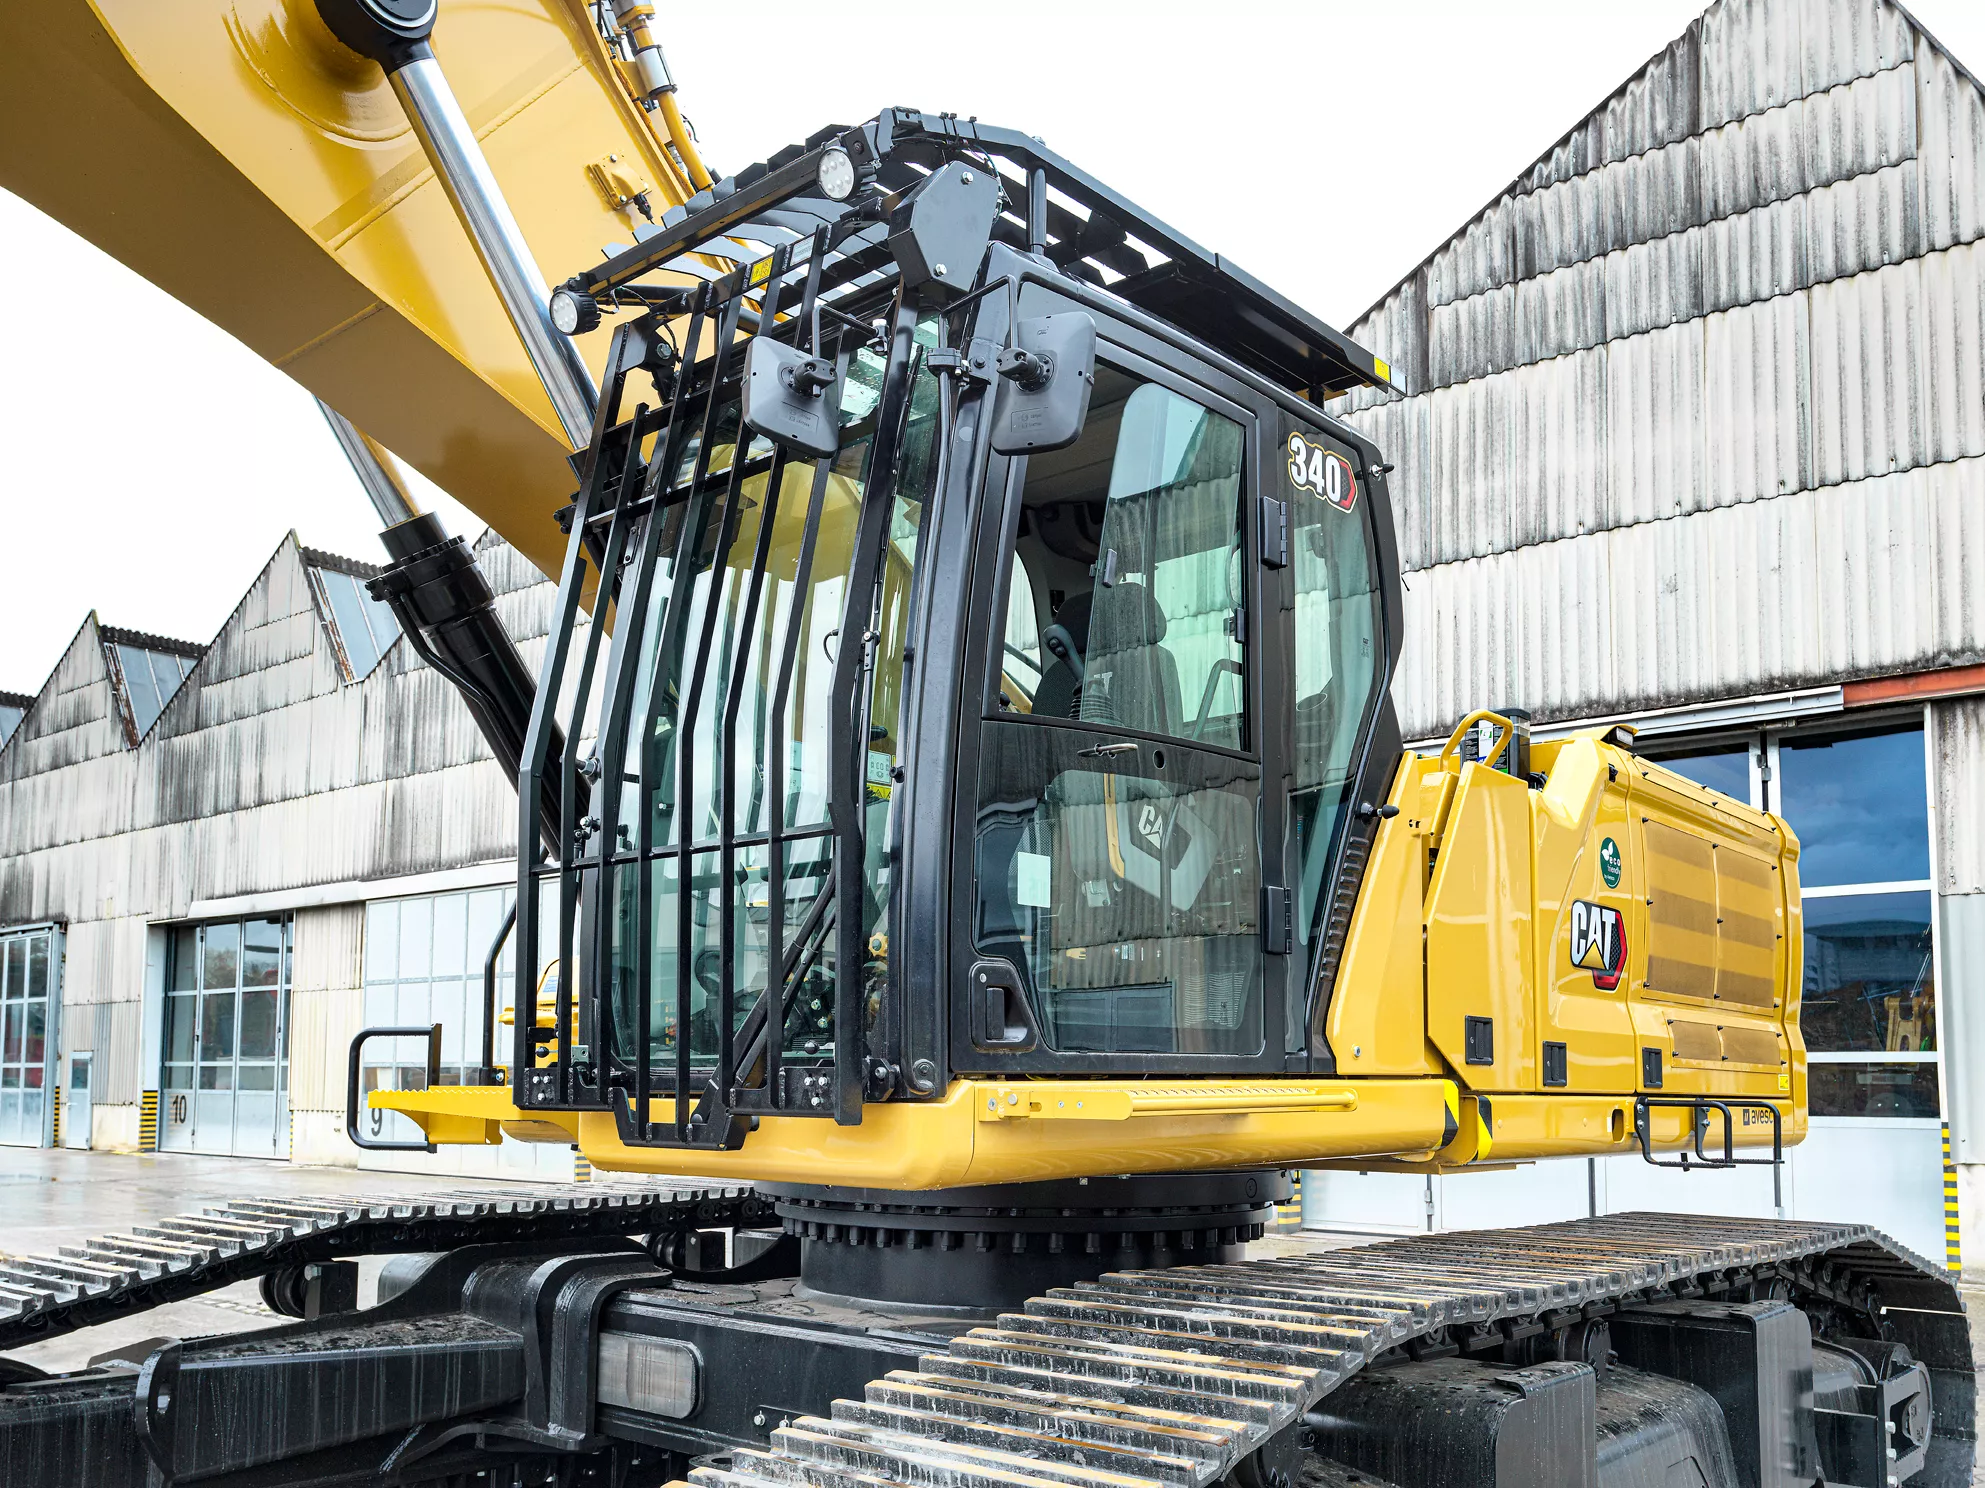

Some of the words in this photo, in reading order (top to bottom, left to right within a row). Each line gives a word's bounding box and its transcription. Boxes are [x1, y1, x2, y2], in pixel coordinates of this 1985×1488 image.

[1291, 437, 1341, 503] 340
[1138, 804, 1163, 836] CA
[1609, 856, 1621, 867] eco
[1571, 901, 1616, 970] CAT
[172, 1095, 187, 1124] 10
[371, 1108, 383, 1137] 9
[1751, 1109, 1774, 1124] avesc
